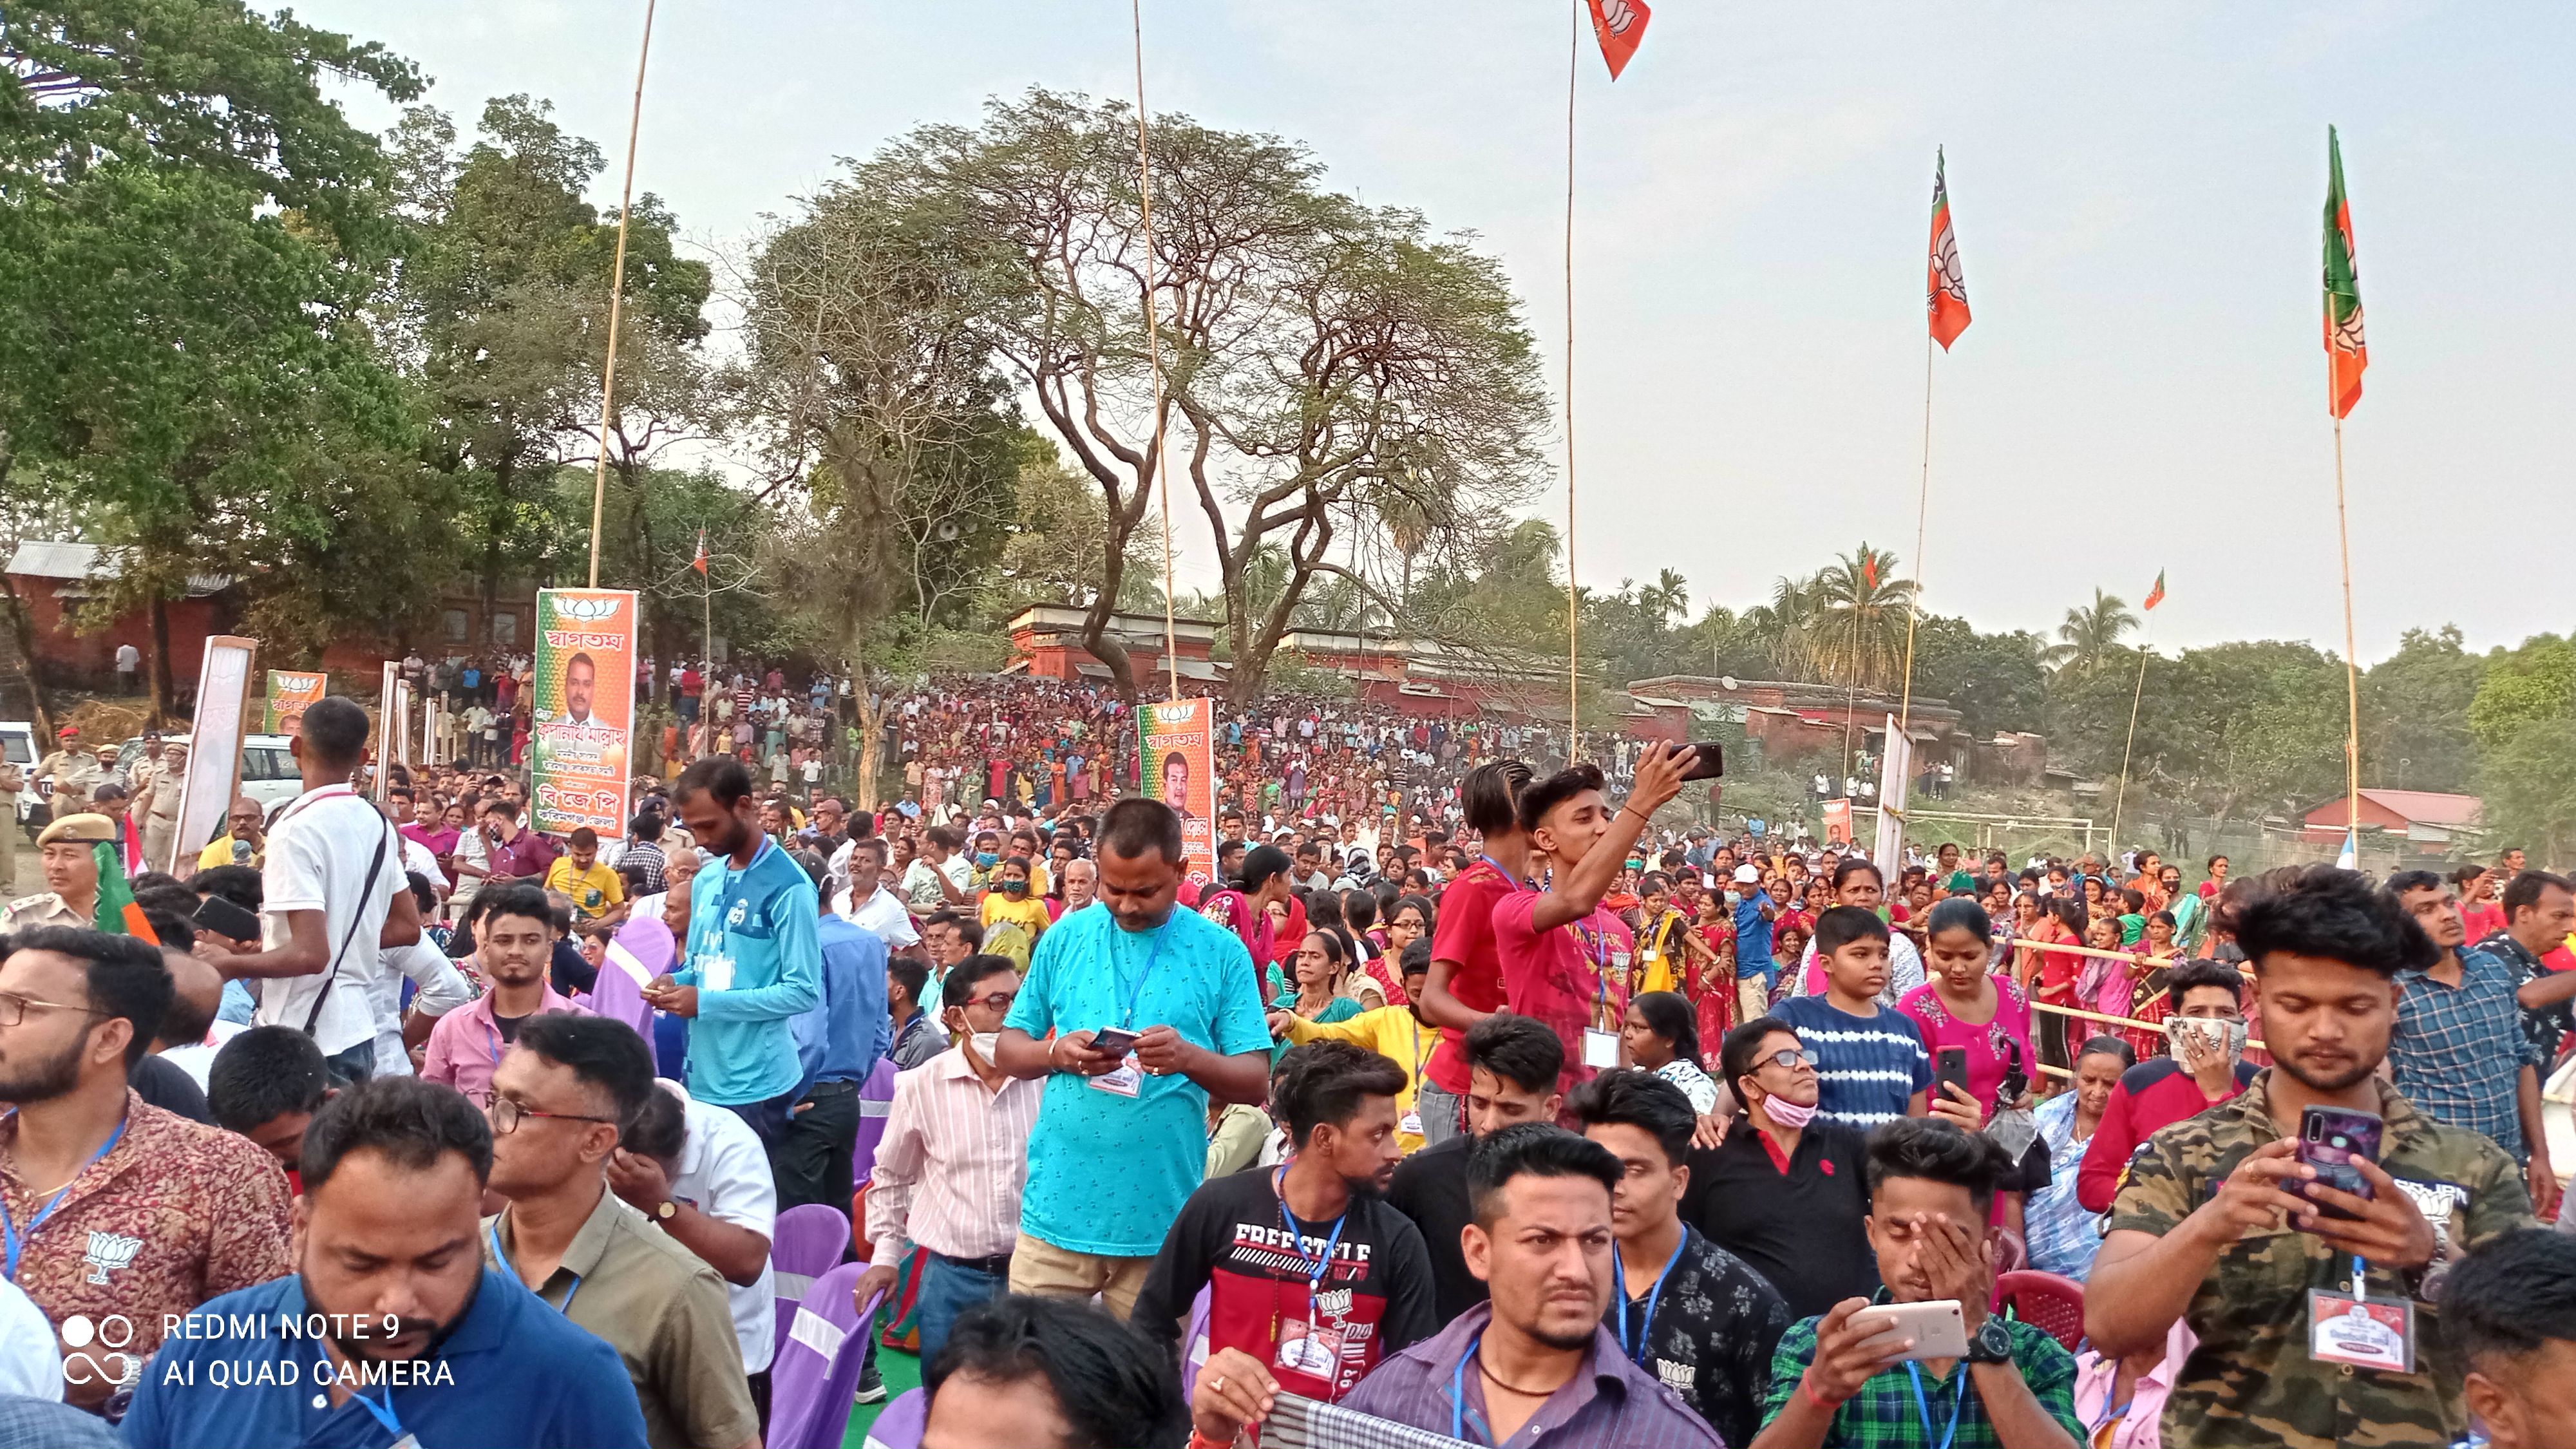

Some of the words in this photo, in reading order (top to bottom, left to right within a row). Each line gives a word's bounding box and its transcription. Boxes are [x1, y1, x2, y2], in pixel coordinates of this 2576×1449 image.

[545, 630, 624, 650] স্বাগতম
[271, 699, 314, 712] স্বাগত
[537, 722, 584, 741] কৃপানাথ
[1146, 732, 1203, 748] স্বাগতম
[537, 784, 558, 806] বি
[561, 791, 591, 810] জে
[593, 790, 620, 813] পি
[537, 809, 585, 825] করিমগঞ্জ
[588, 816, 616, 829] জেলা
